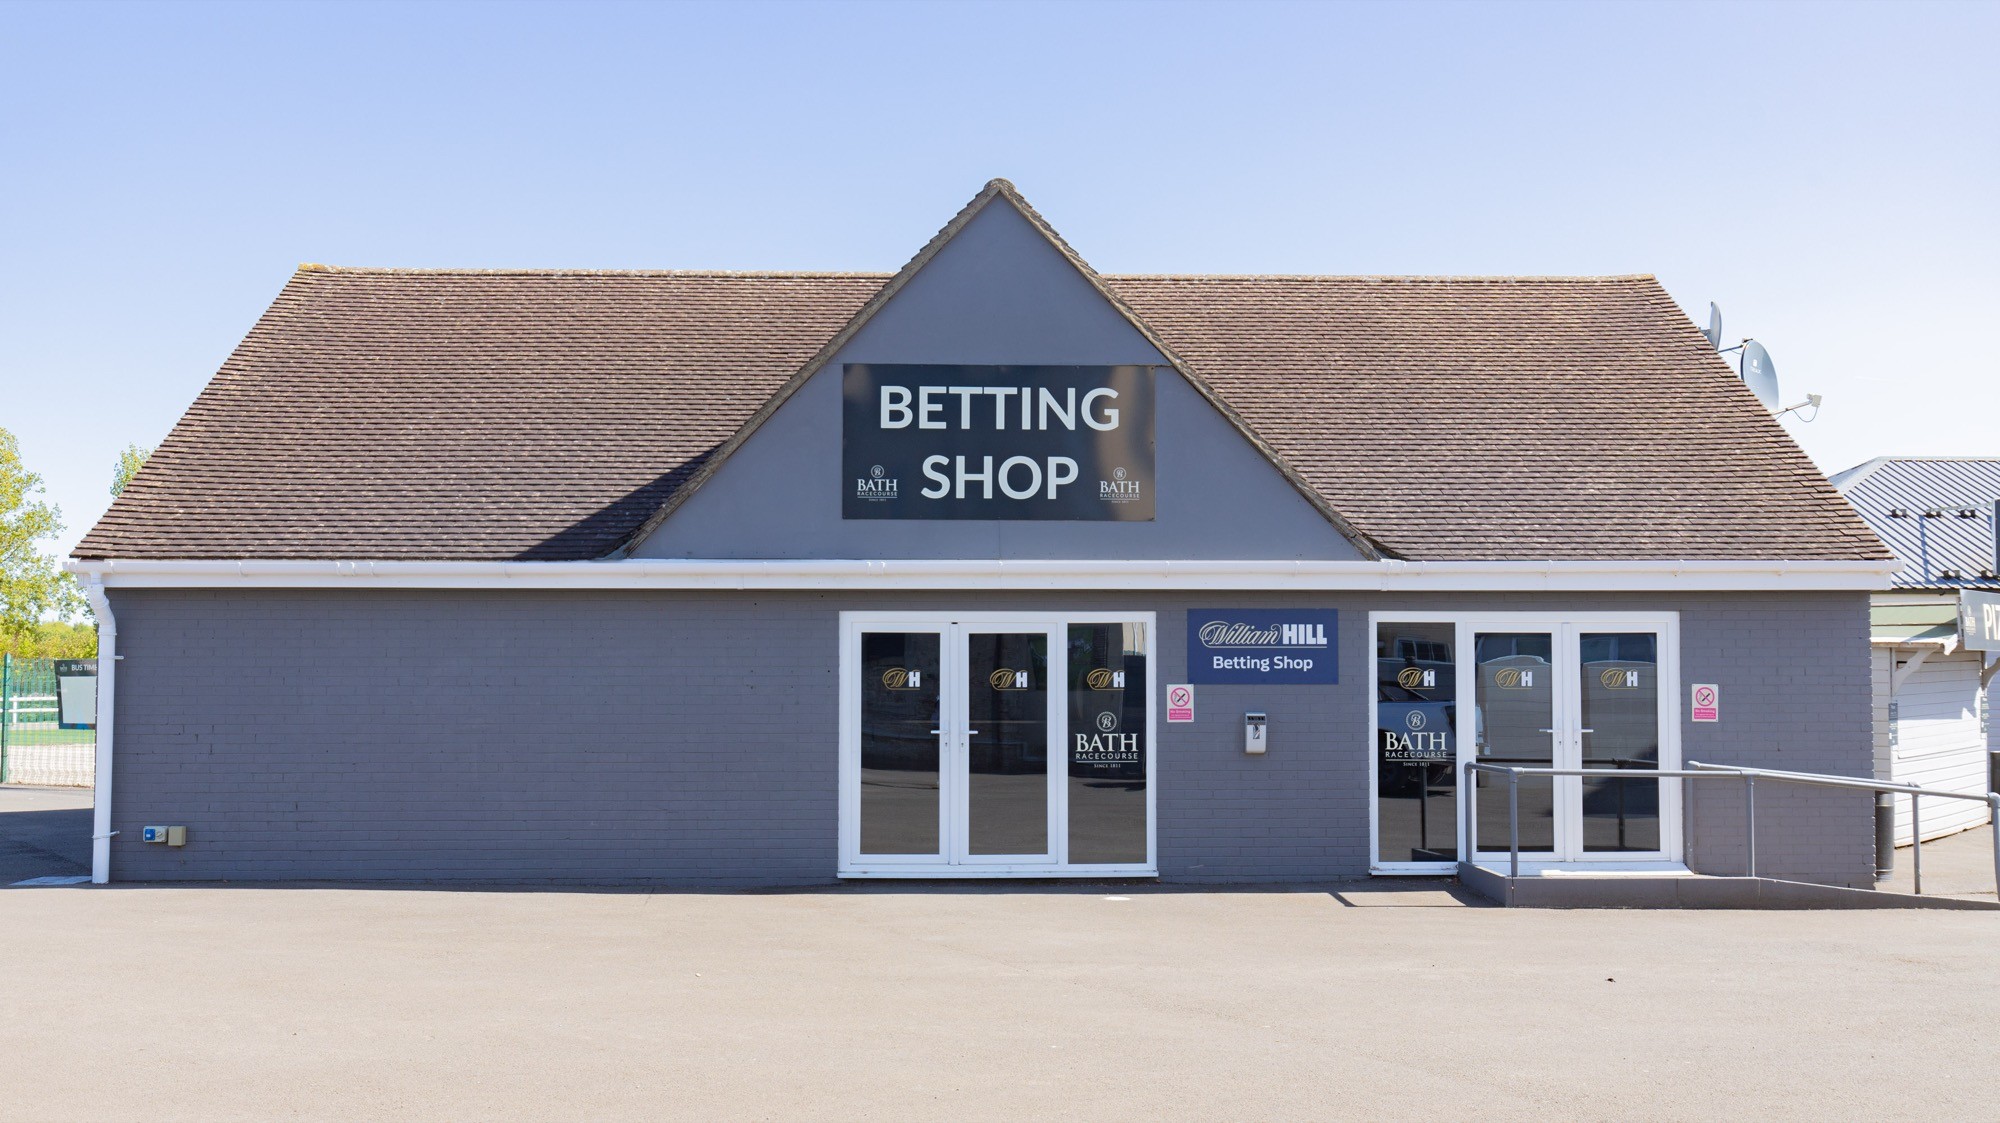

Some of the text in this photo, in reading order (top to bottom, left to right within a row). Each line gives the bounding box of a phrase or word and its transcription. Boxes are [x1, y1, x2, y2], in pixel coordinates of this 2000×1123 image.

[880, 385, 1120, 431] BETTING
[856, 478, 898, 491] BATH
[920, 454, 1079, 500] SHOP
[1099, 480, 1140, 493] BATH
[1199, 620, 1328, 648] William HILL
[1213, 655, 1313, 672] Betting Shop
[1075, 733, 1139, 752] BATH
[1385, 732, 1448, 751] BATH
[1075, 752, 1138, 760] RACECOURSE
